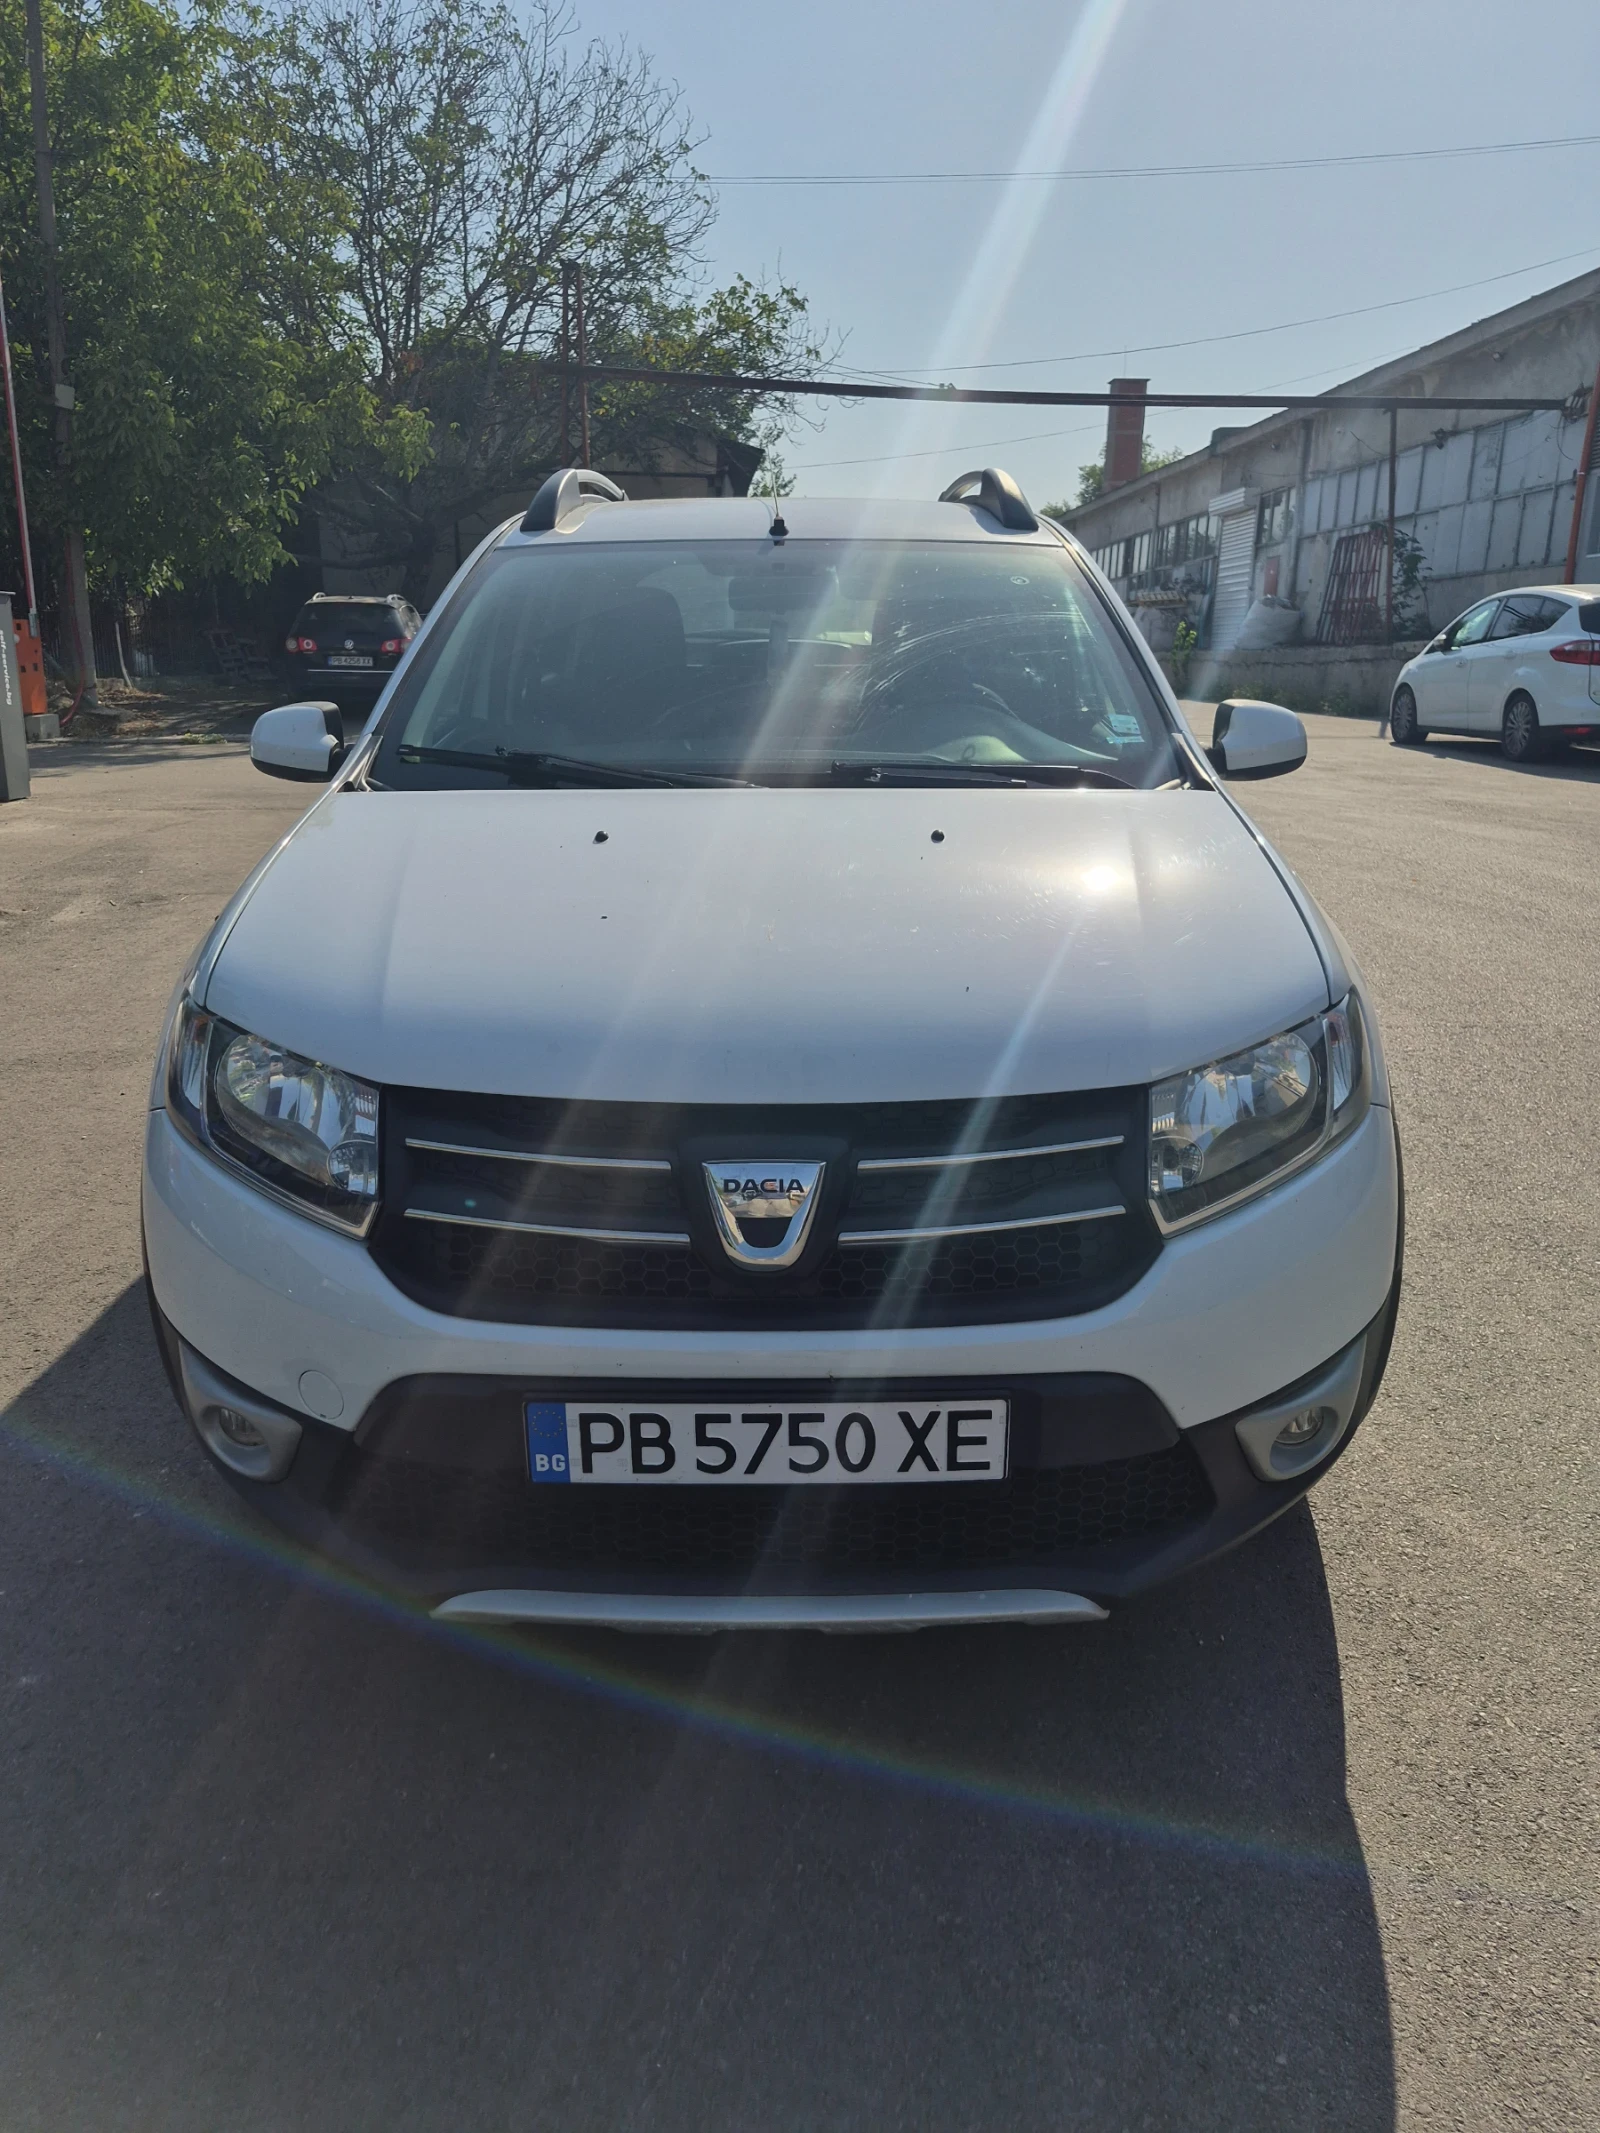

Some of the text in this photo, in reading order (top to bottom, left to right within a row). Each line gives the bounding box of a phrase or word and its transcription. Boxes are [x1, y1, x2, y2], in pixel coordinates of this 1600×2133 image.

[723, 1178, 805, 1193] DACIA
[579, 1409, 993, 1475] PB 5750 XE
[535, 1453, 566, 1472] BG
